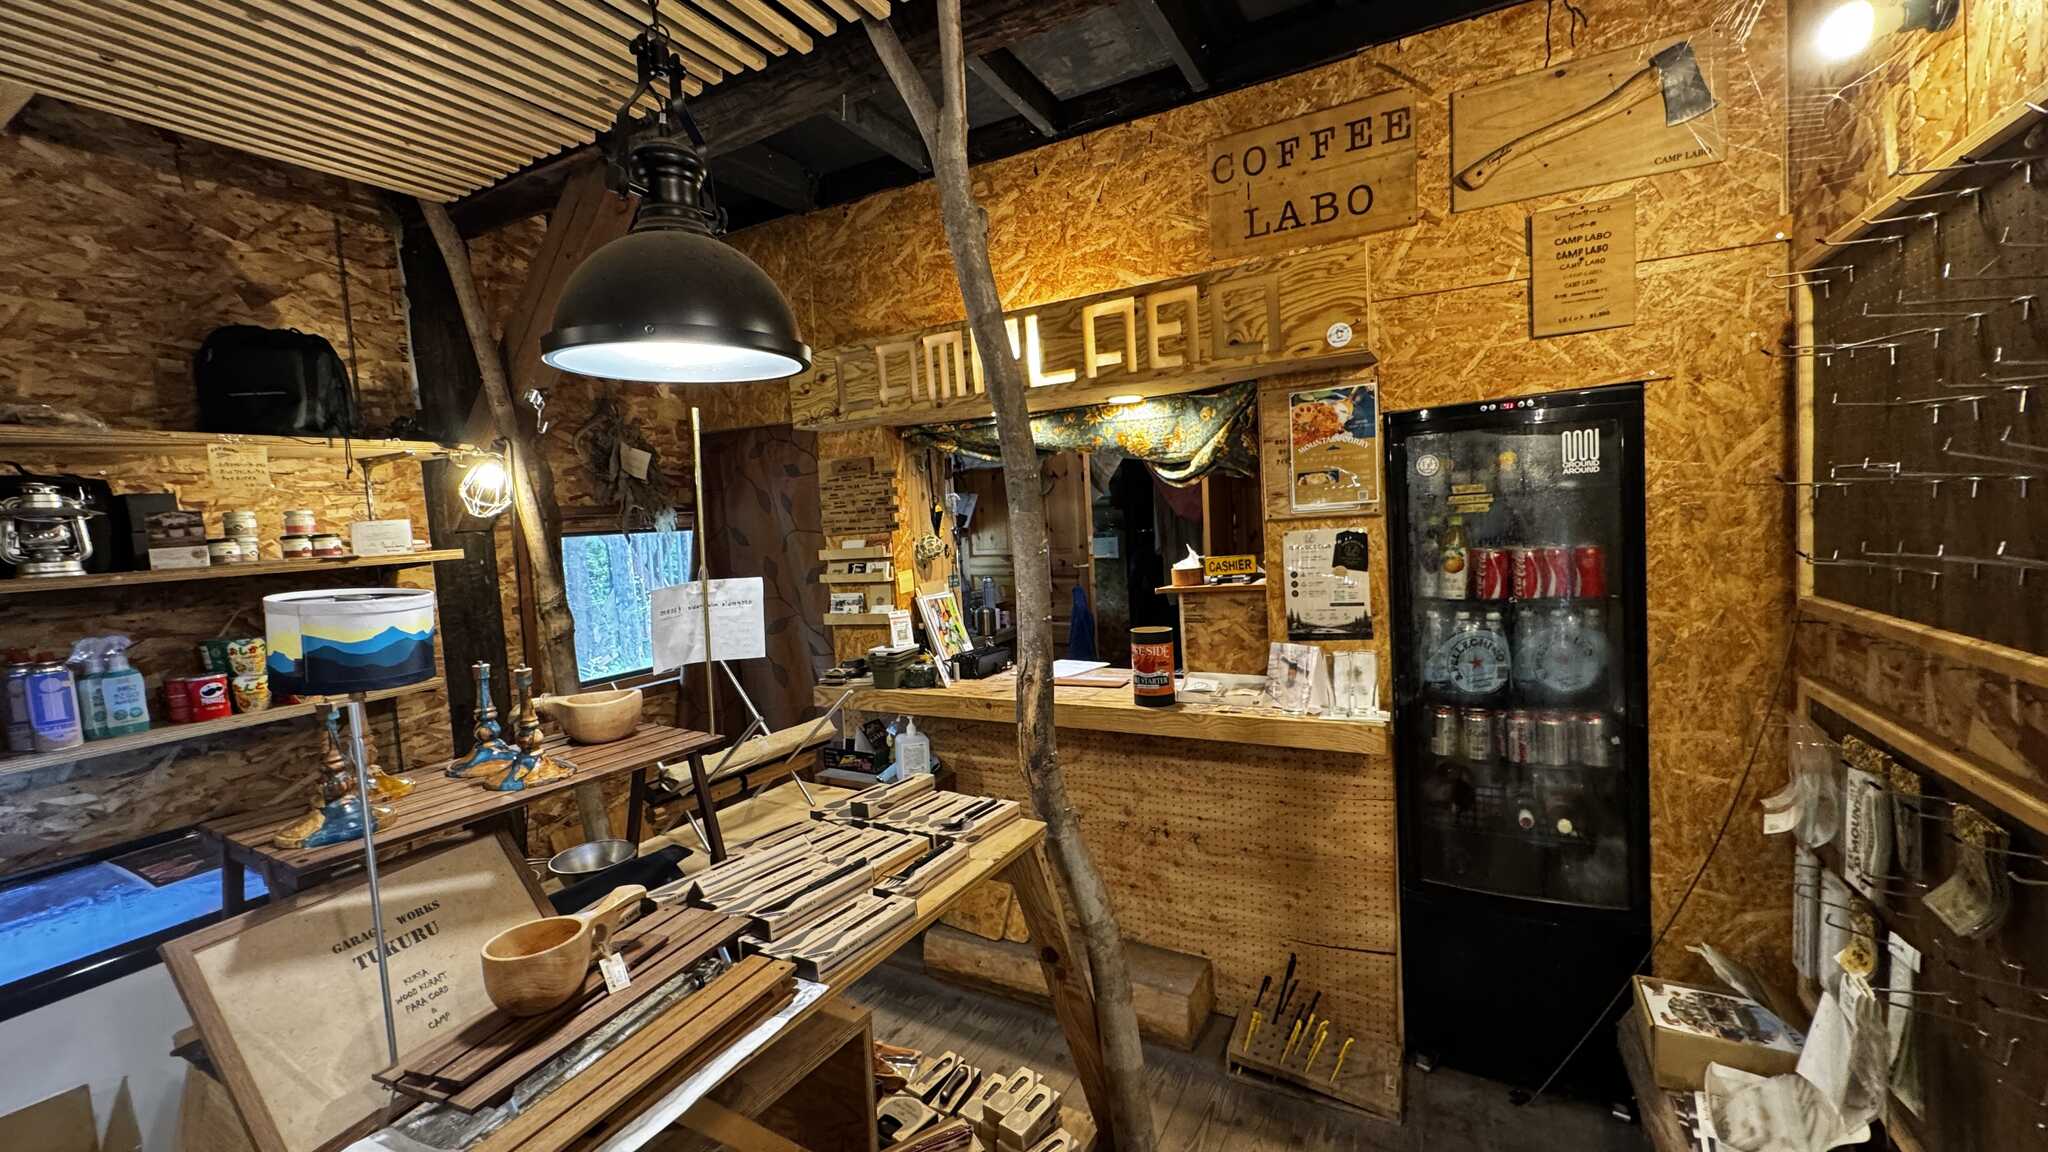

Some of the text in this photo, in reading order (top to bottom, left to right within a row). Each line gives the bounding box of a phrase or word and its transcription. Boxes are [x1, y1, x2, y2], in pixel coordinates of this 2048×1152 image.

[1211, 106, 1411, 184] COFFEE
[1654, 146, 1712, 165] CAMP LABO
[1244, 184, 1374, 239] LABO
[1554, 231, 1612, 246] CAMP LABO
[1556, 244, 1609, 260] CAMP LABO
[1562, 460, 1600, 468] GROUND
[1562, 466, 1600, 475] AROUND
[1208, 559, 1252, 572] CASHIER
[332, 900, 440, 954] GARAG WORKS
[352, 920, 440, 970] TUKURU
[395, 988, 418, 1004] WOOD
[405, 985, 449, 1013] PARA CORD
[428, 1011, 450, 1029] CAMP
